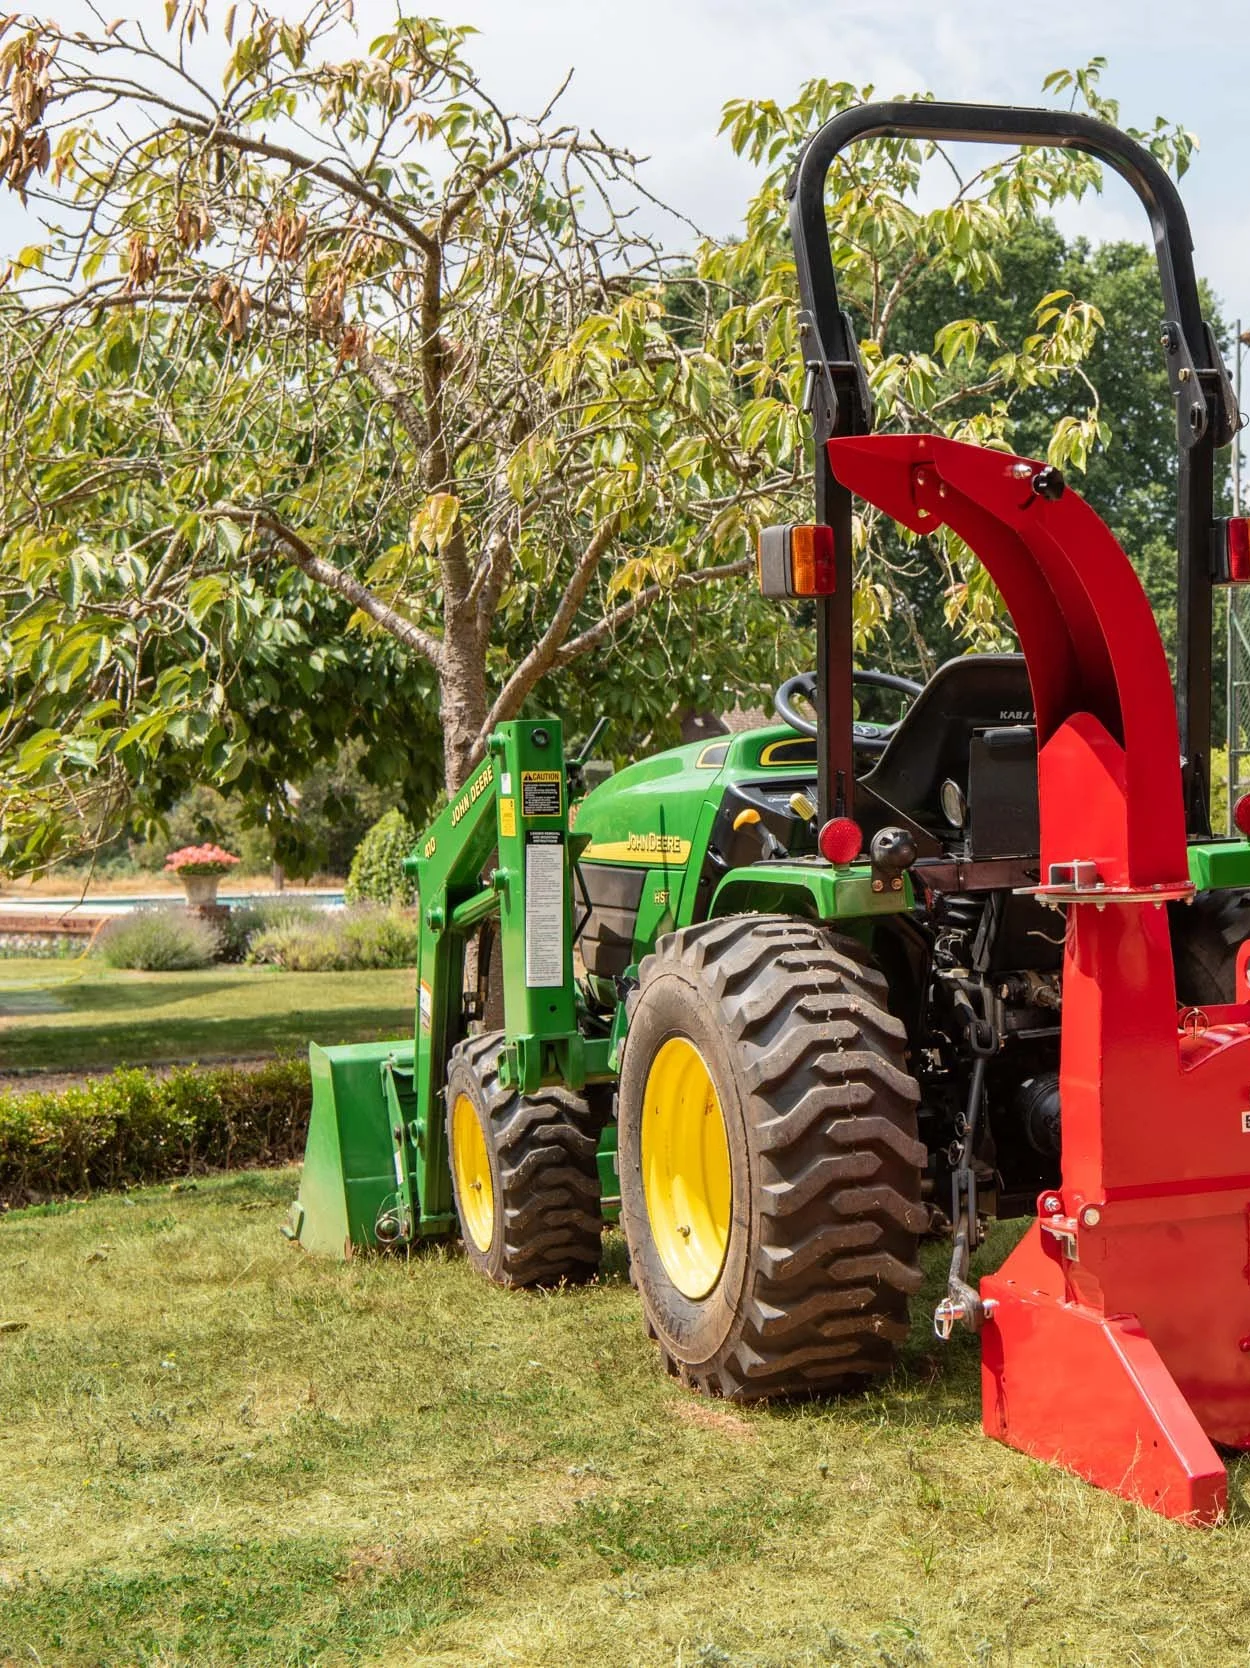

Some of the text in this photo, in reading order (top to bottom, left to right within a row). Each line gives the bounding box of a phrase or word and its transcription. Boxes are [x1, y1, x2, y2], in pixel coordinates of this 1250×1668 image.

[532, 772, 559, 781] CAUTION
[451, 764, 493, 827] JOHN DEERE
[627, 831, 681, 853] JOHN DEERE
[654, 890, 670, 904] HST
